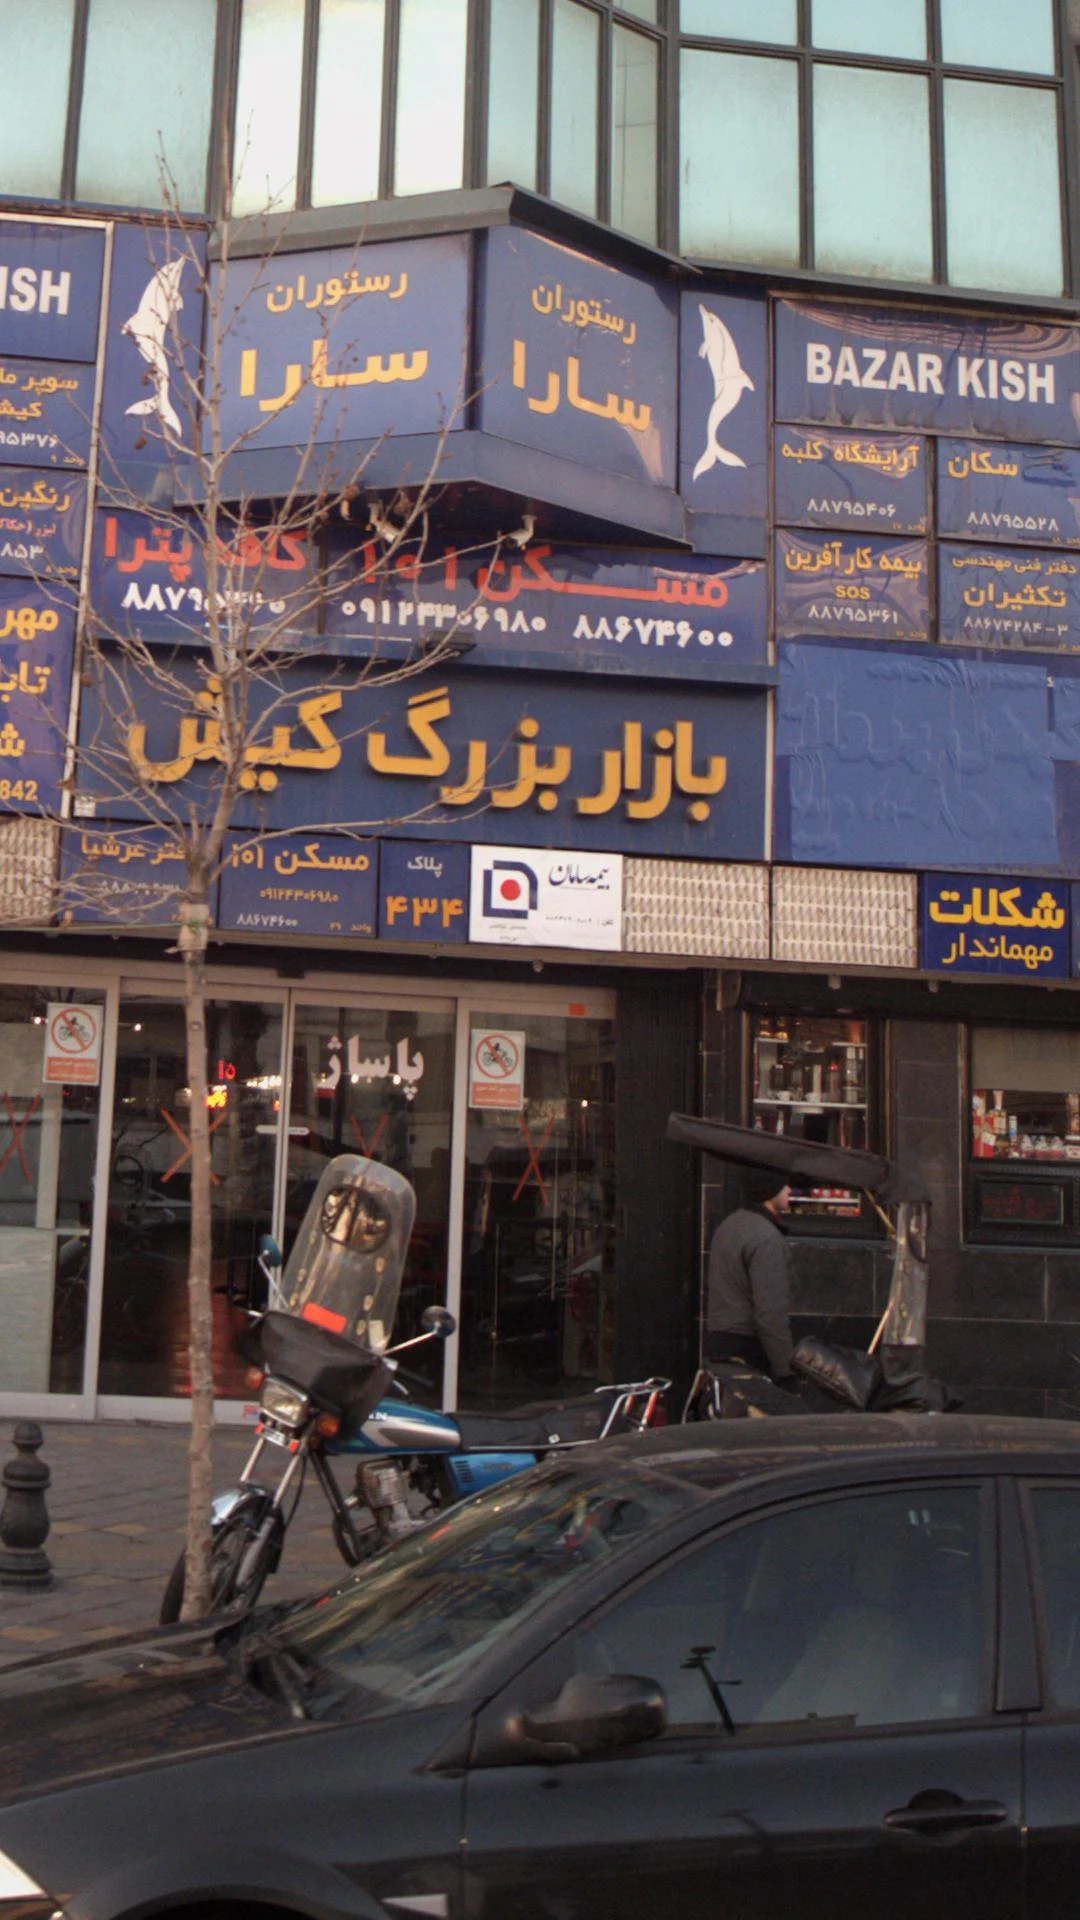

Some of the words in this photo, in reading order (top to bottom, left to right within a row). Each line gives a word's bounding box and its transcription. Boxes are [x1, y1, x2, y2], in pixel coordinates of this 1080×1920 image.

[266, 271, 408, 313] رستوران
[531, 283, 637, 345] رستوران
[20, 375, 78, 396] سوپر
[240, 338, 428, 413] سارا
[512, 339, 652, 432] سارا
[806, 343, 944, 395] BAZAR
[957, 356, 1055, 404] KISH
[781, 439, 826, 464] کلبه
[833, 439, 920, 473] آرایشگاه
[948, 451, 1019, 478] سکان
[807, 498, 897, 518] ۸۸۷۹۵۴۰۶
[967, 511, 1060, 532] ۸۸۷۹۵۵۲۸
[104, 517, 193, 582] پترا
[785, 541, 842, 572] آفرین
[952, 555, 1012, 572] مهندسی
[1014, 557, 1042, 574] فنی
[477, 544, 729, 609] مسکن
[879, 554, 922, 579] بیمه
[1044, 560, 1077, 576] دفتر
[963, 582, 1067, 611] تکثیران
[808, 604, 899, 624] ۸۸۷۹۵۳۶۱
[572, 614, 734, 649] ۸۸۶۷۴۶۰۰
[127, 676, 343, 792] کیش
[367, 686, 571, 812] بزرگ
[576, 721, 727, 821] بازار
[274, 843, 370, 875] مسکن
[407, 854, 444, 879] پلاک
[385, 895, 465, 928] ۴۳۴
[929, 887, 1065, 929] شکلات
[942, 932, 1053, 970] مهماندار
